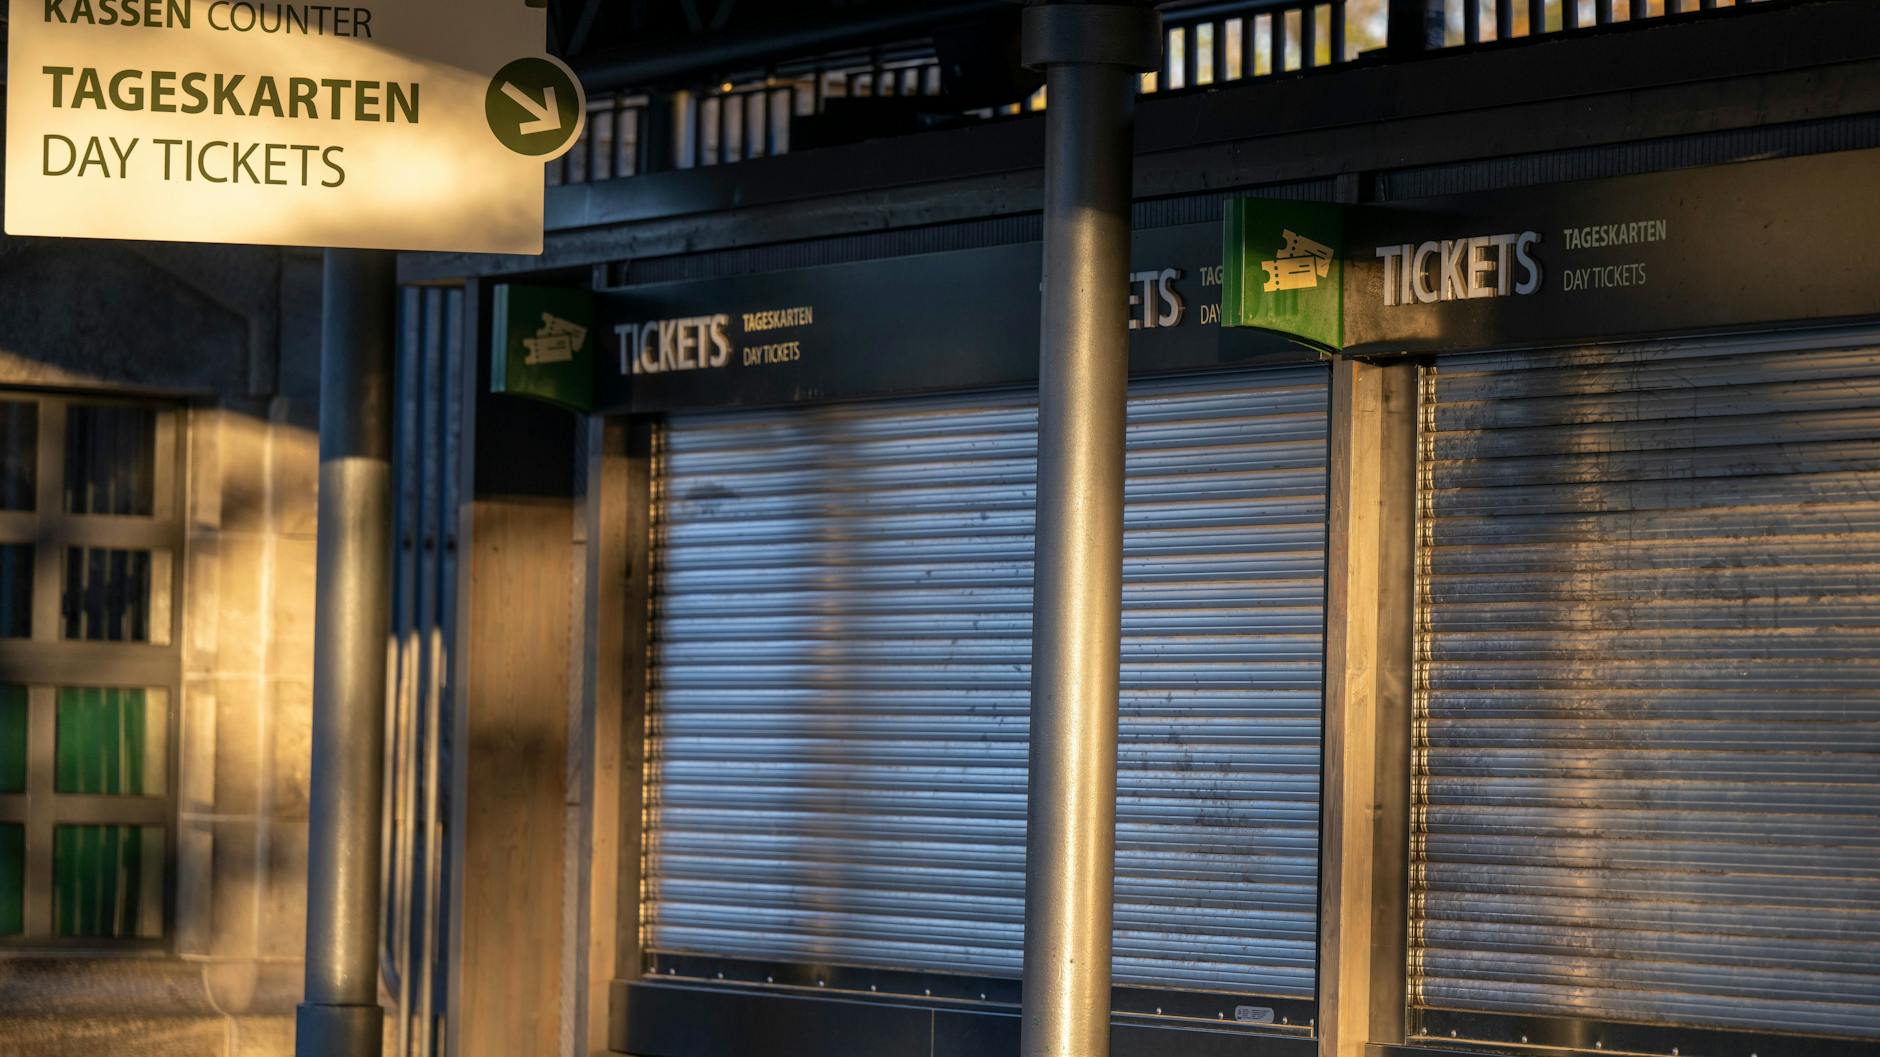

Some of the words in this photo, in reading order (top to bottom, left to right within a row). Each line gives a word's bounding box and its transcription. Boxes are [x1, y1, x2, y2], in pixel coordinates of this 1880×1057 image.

[44, 0, 191, 29] KASSEN
[208, 1, 373, 38] COUNTER
[42, 66, 420, 124] TAGESKARTEN
[43, 134, 139, 179] DAY
[153, 139, 345, 188] TICKETS
[1563, 219, 1667, 250] TAGESKARTEN
[1375, 230, 1543, 307] TICKETS
[1563, 267, 1591, 292] DAY
[1591, 263, 1647, 289] TICKETS
[742, 306, 813, 332] TAGESKARTEN
[614, 313, 732, 375] TICKETS
[743, 346, 762, 366] DAY
[762, 341, 800, 364] TICKETS
